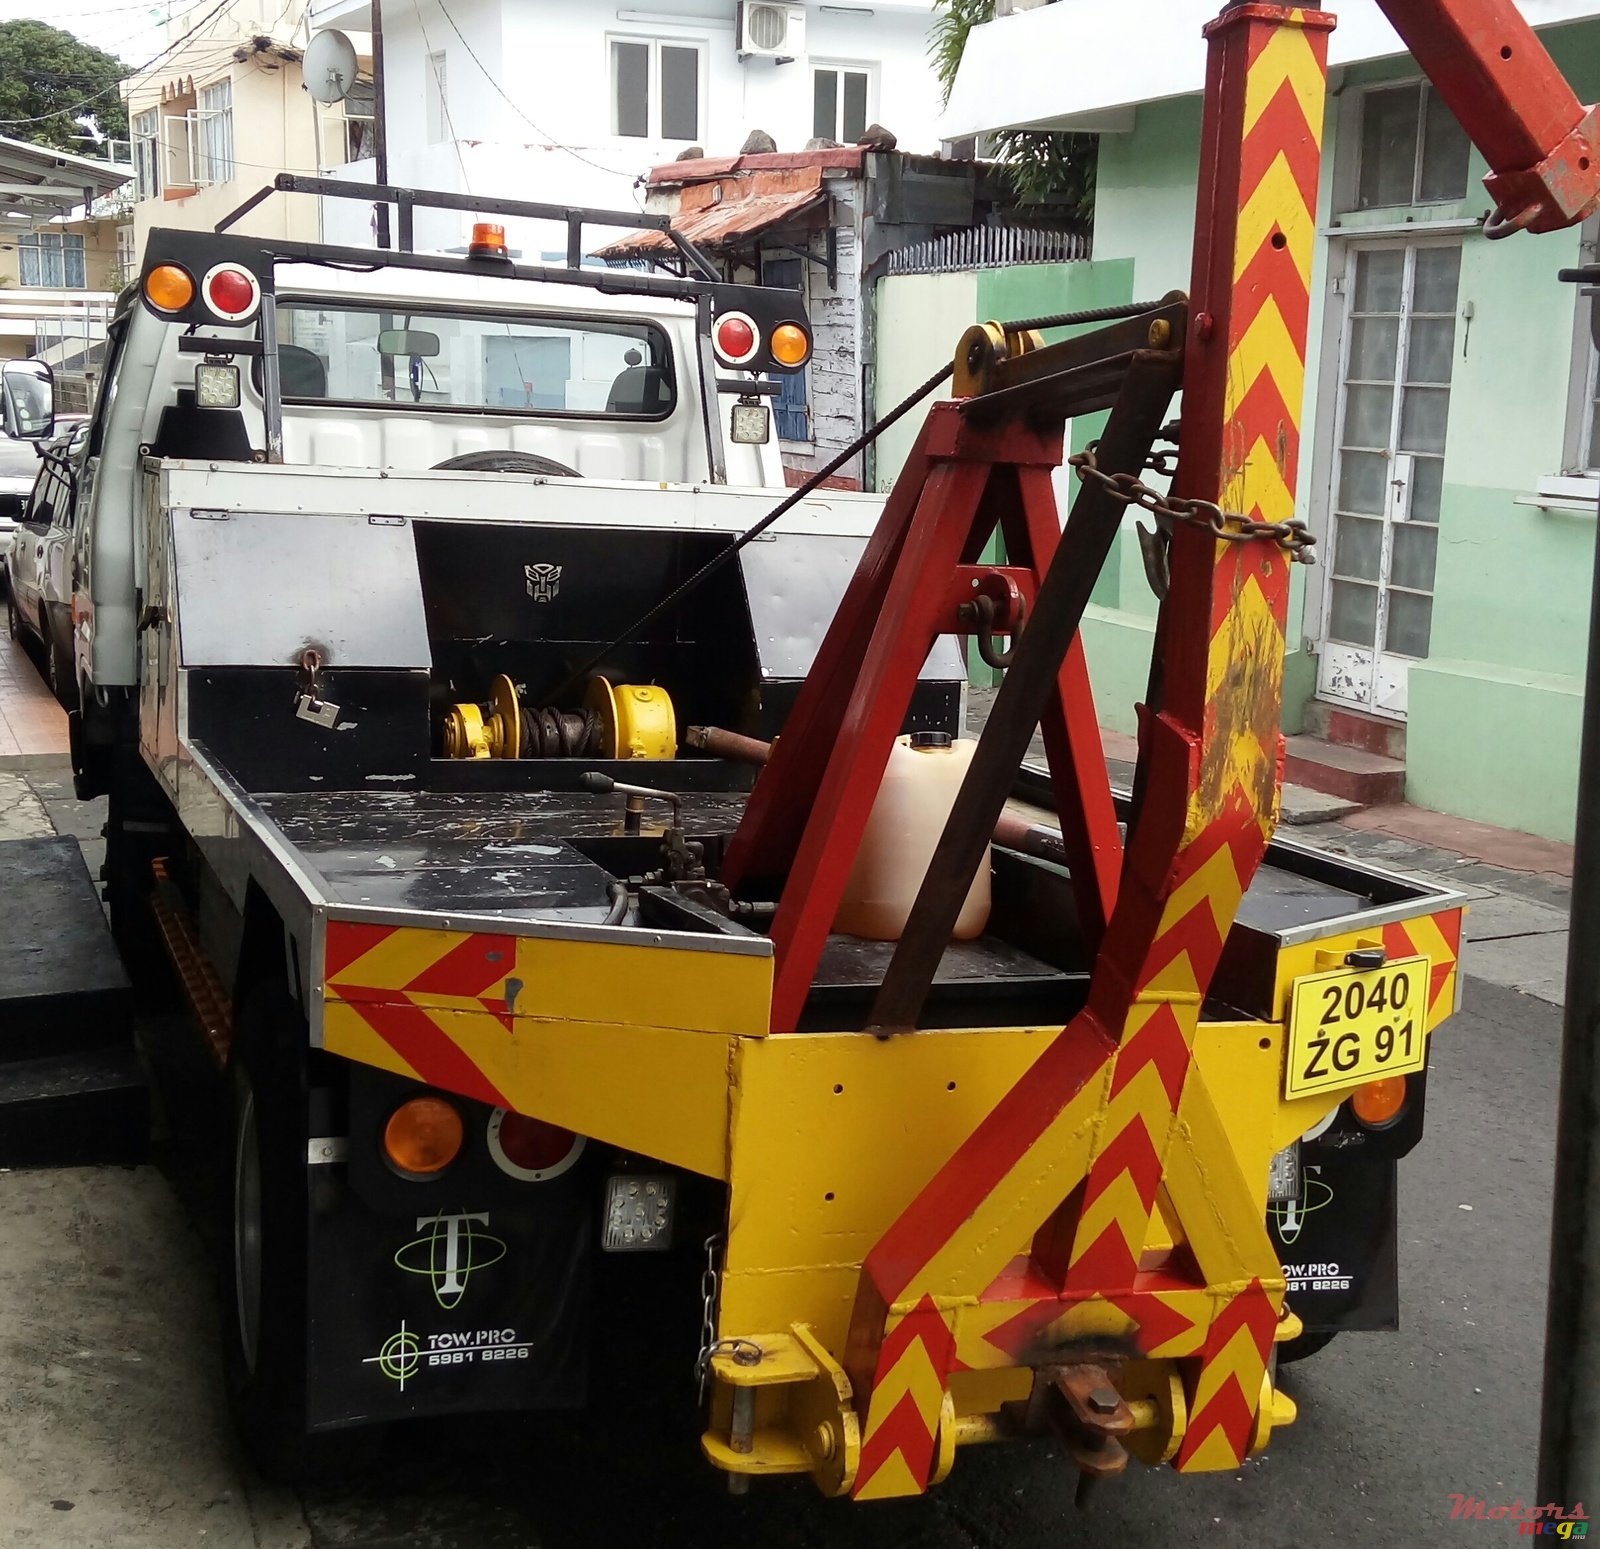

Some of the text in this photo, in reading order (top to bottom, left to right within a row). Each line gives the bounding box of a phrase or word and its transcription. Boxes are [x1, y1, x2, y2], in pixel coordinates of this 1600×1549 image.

[1319, 972, 1410, 1026] 2040
[1303, 1019, 1413, 1080] ZG 91
[1281, 1262, 1340, 1278] OW.PRO
[1286, 1280, 1350, 1291] 81 8226
[427, 1328, 516, 1349] TOW.PRO
[428, 1347, 529, 1366] 5981 8226
